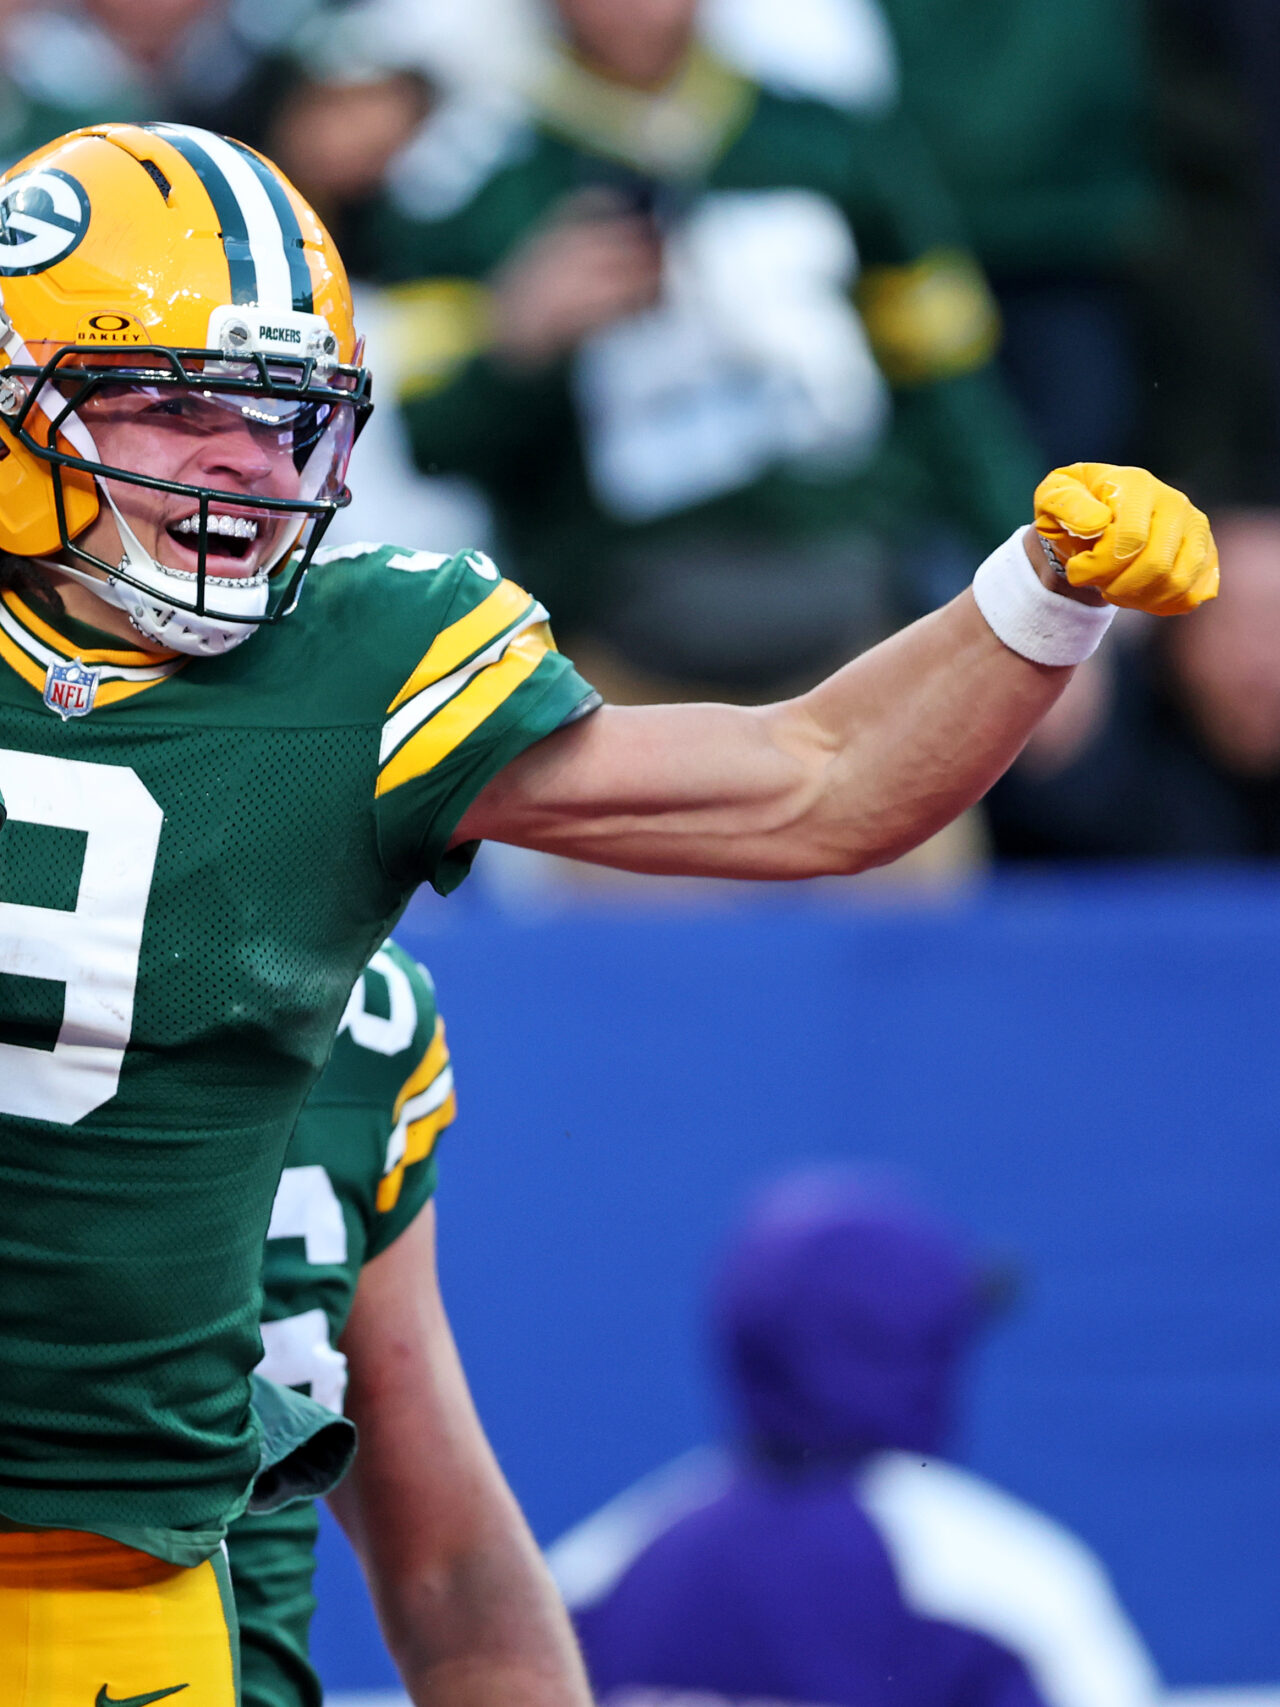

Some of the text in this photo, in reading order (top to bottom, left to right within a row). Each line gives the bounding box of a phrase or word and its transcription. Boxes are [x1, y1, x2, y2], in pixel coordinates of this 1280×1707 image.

[78, 332, 140, 342] OAKLEY
[259, 325, 301, 344] PACKERS
[51, 682, 84, 709] NFL
